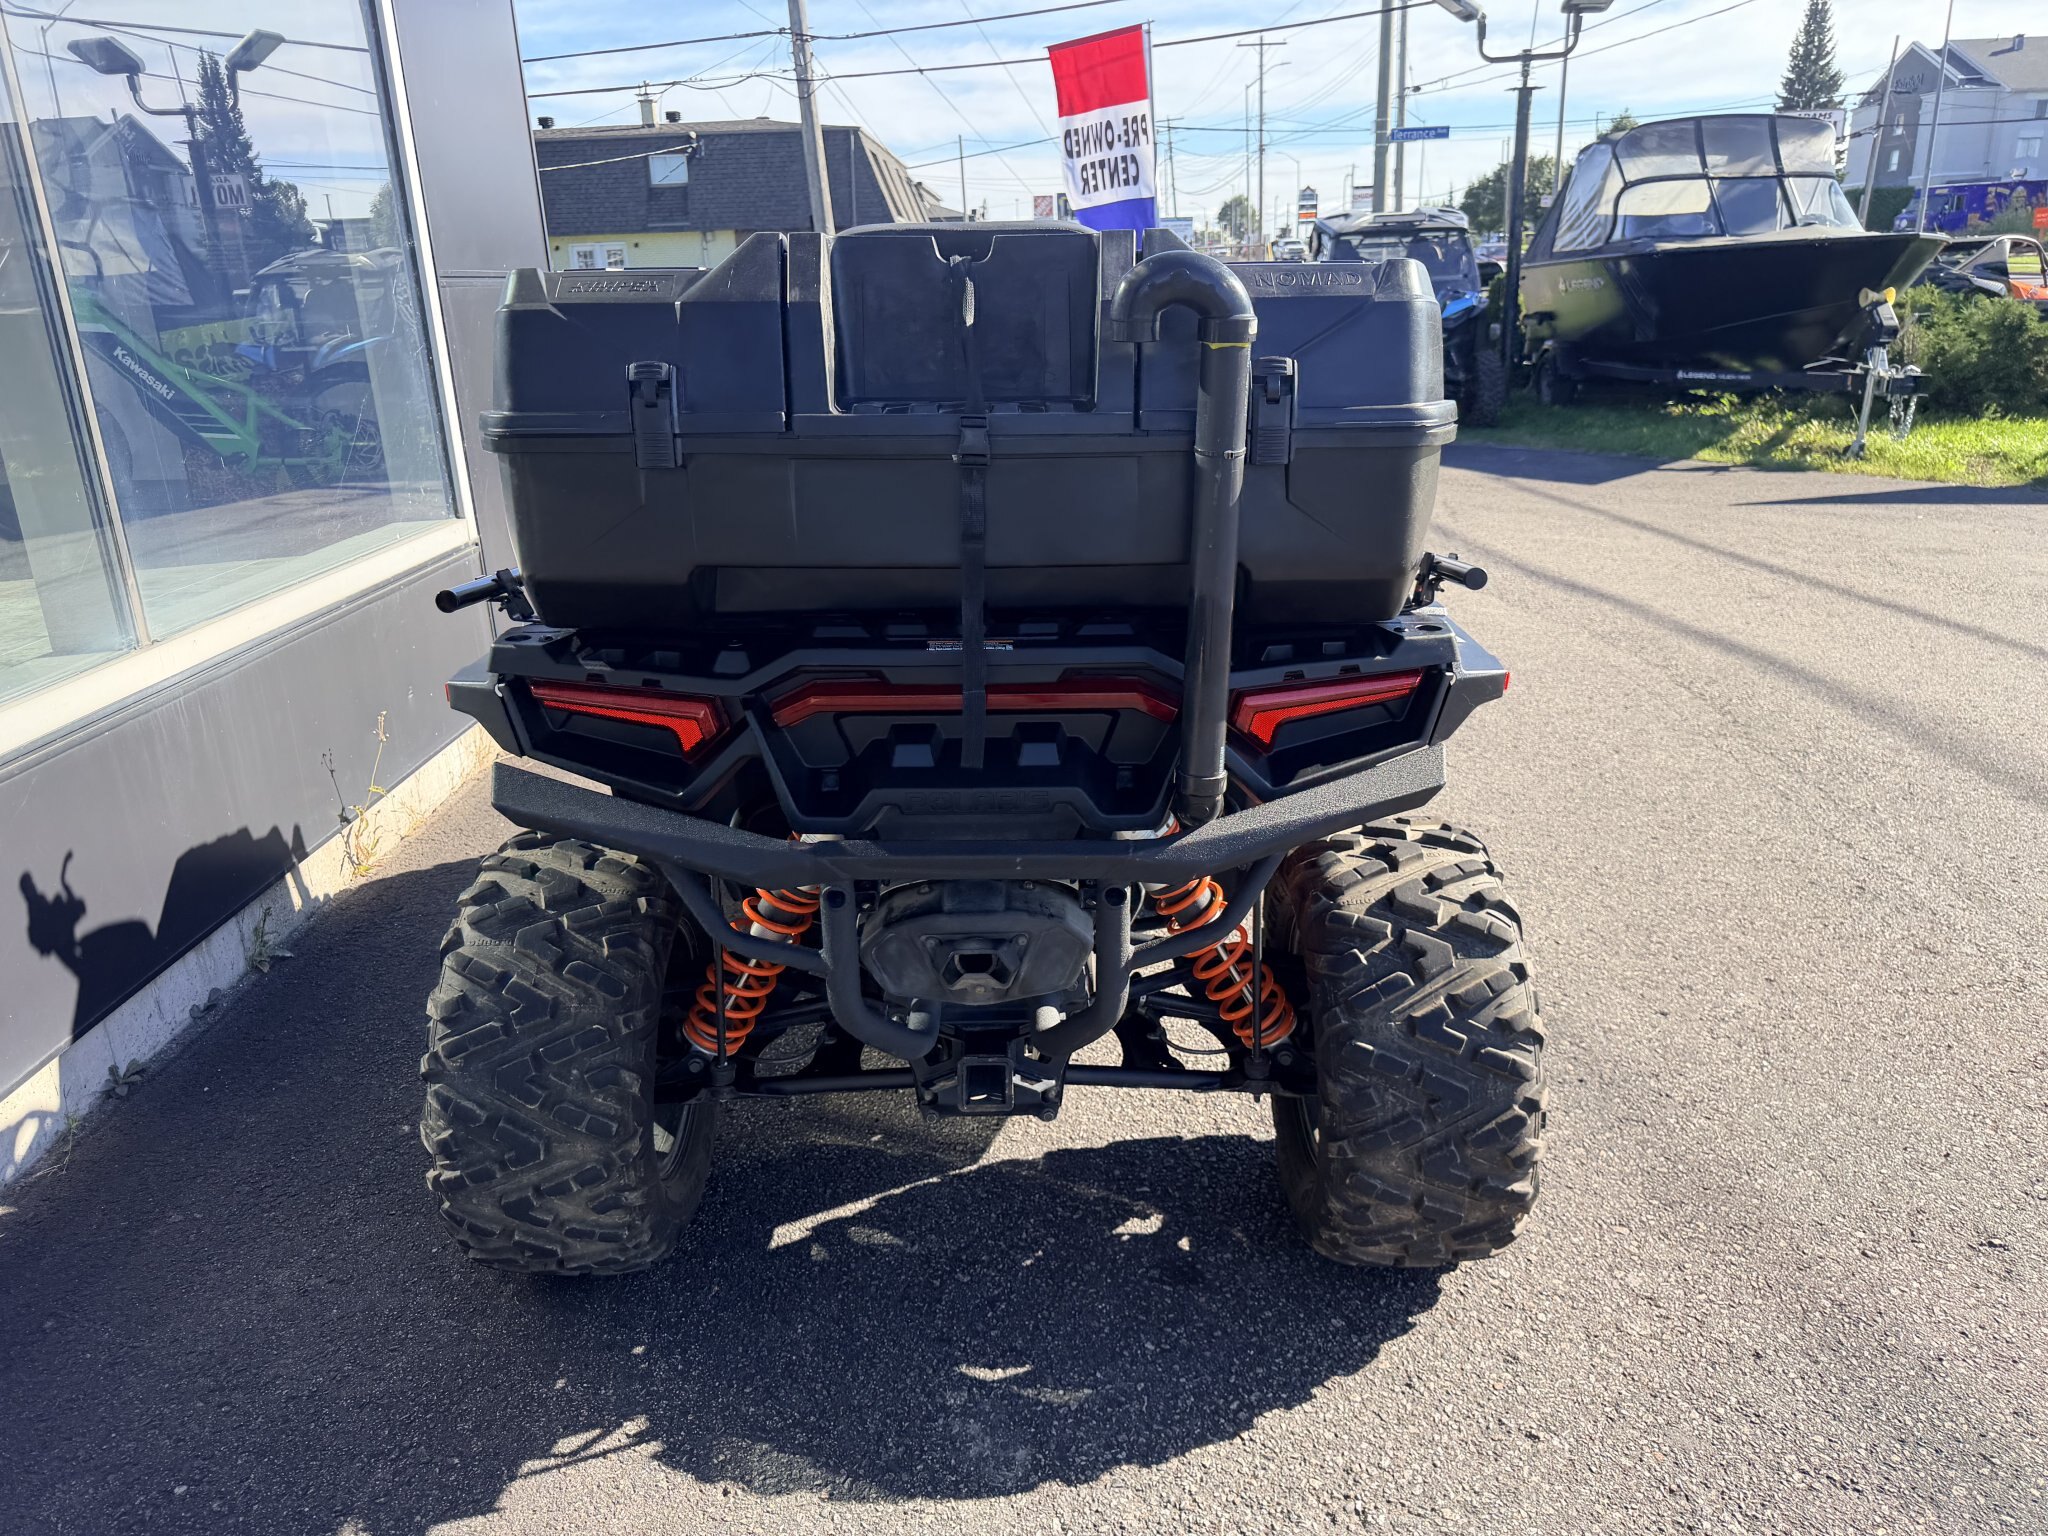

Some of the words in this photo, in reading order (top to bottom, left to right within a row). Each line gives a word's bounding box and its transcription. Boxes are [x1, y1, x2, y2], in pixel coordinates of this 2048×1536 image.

[1393, 129, 1436, 140] Terrance
[1254, 271, 1362, 287] NOMAD
[113, 346, 175, 400] Kawasaki
[904, 791, 1050, 813] POLARIS
